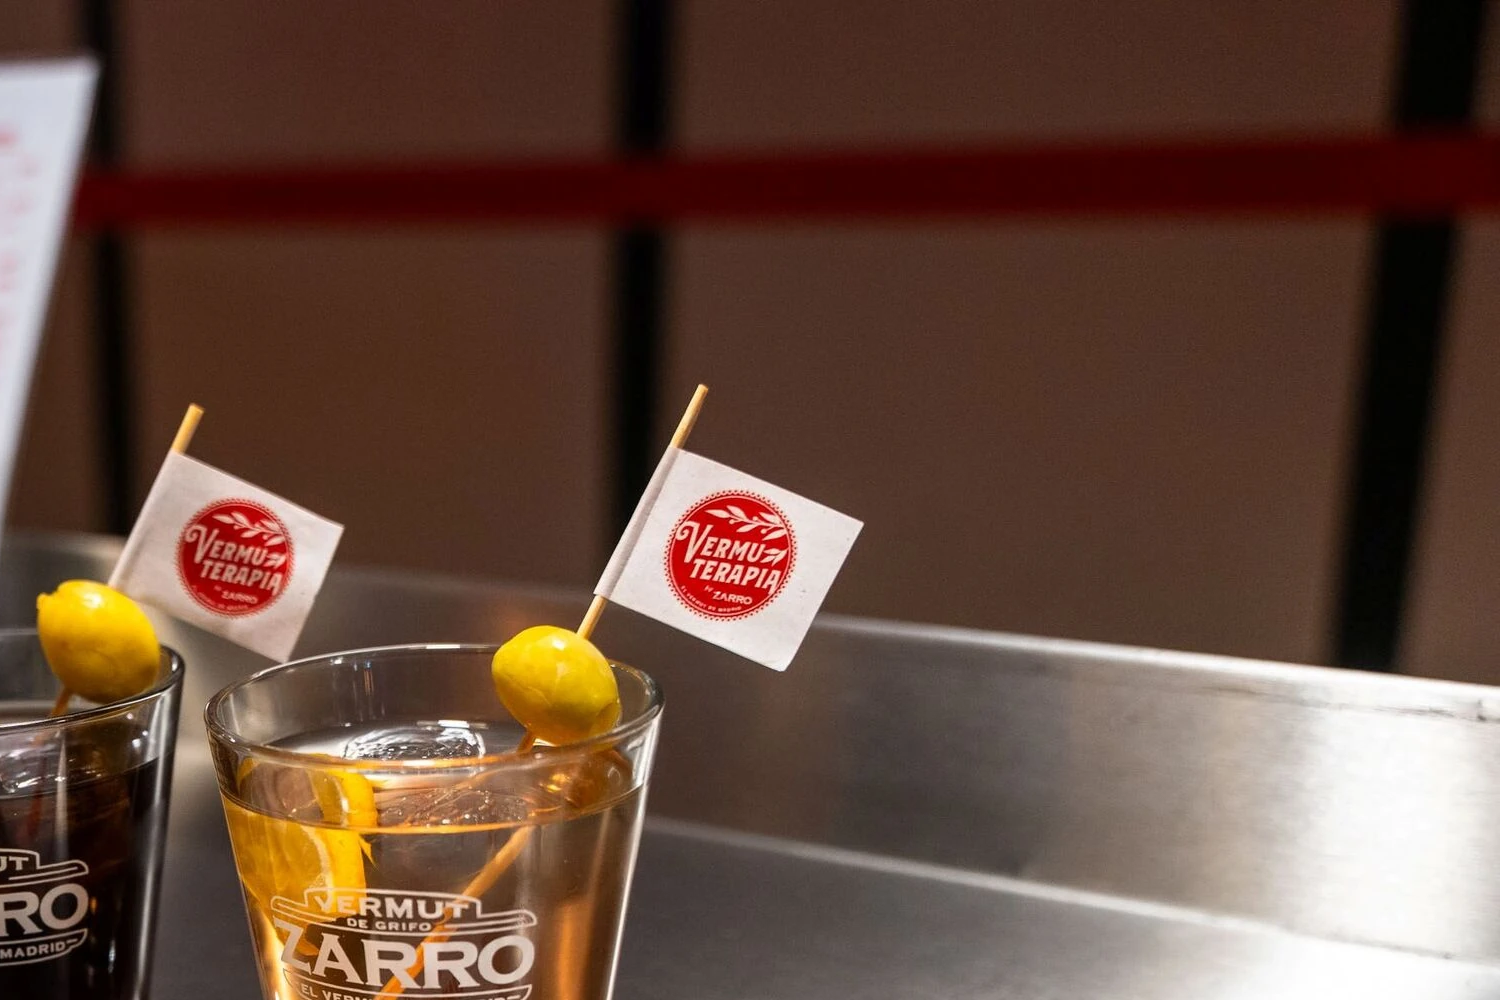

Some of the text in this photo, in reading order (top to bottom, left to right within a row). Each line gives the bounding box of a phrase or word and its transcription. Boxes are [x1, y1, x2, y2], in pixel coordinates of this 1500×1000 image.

[200, 560, 283, 596] TERAPIA
[689, 558, 782, 596] TERAPIA
[712, 591, 753, 605] ZARRO
[314, 894, 470, 920] VERMUT
[346, 918, 432, 932] DE GRIFO
[0, 939, 67, 959] MADRID
[273, 916, 535, 990] ZARRO
[301, 984, 319, 999] EL
